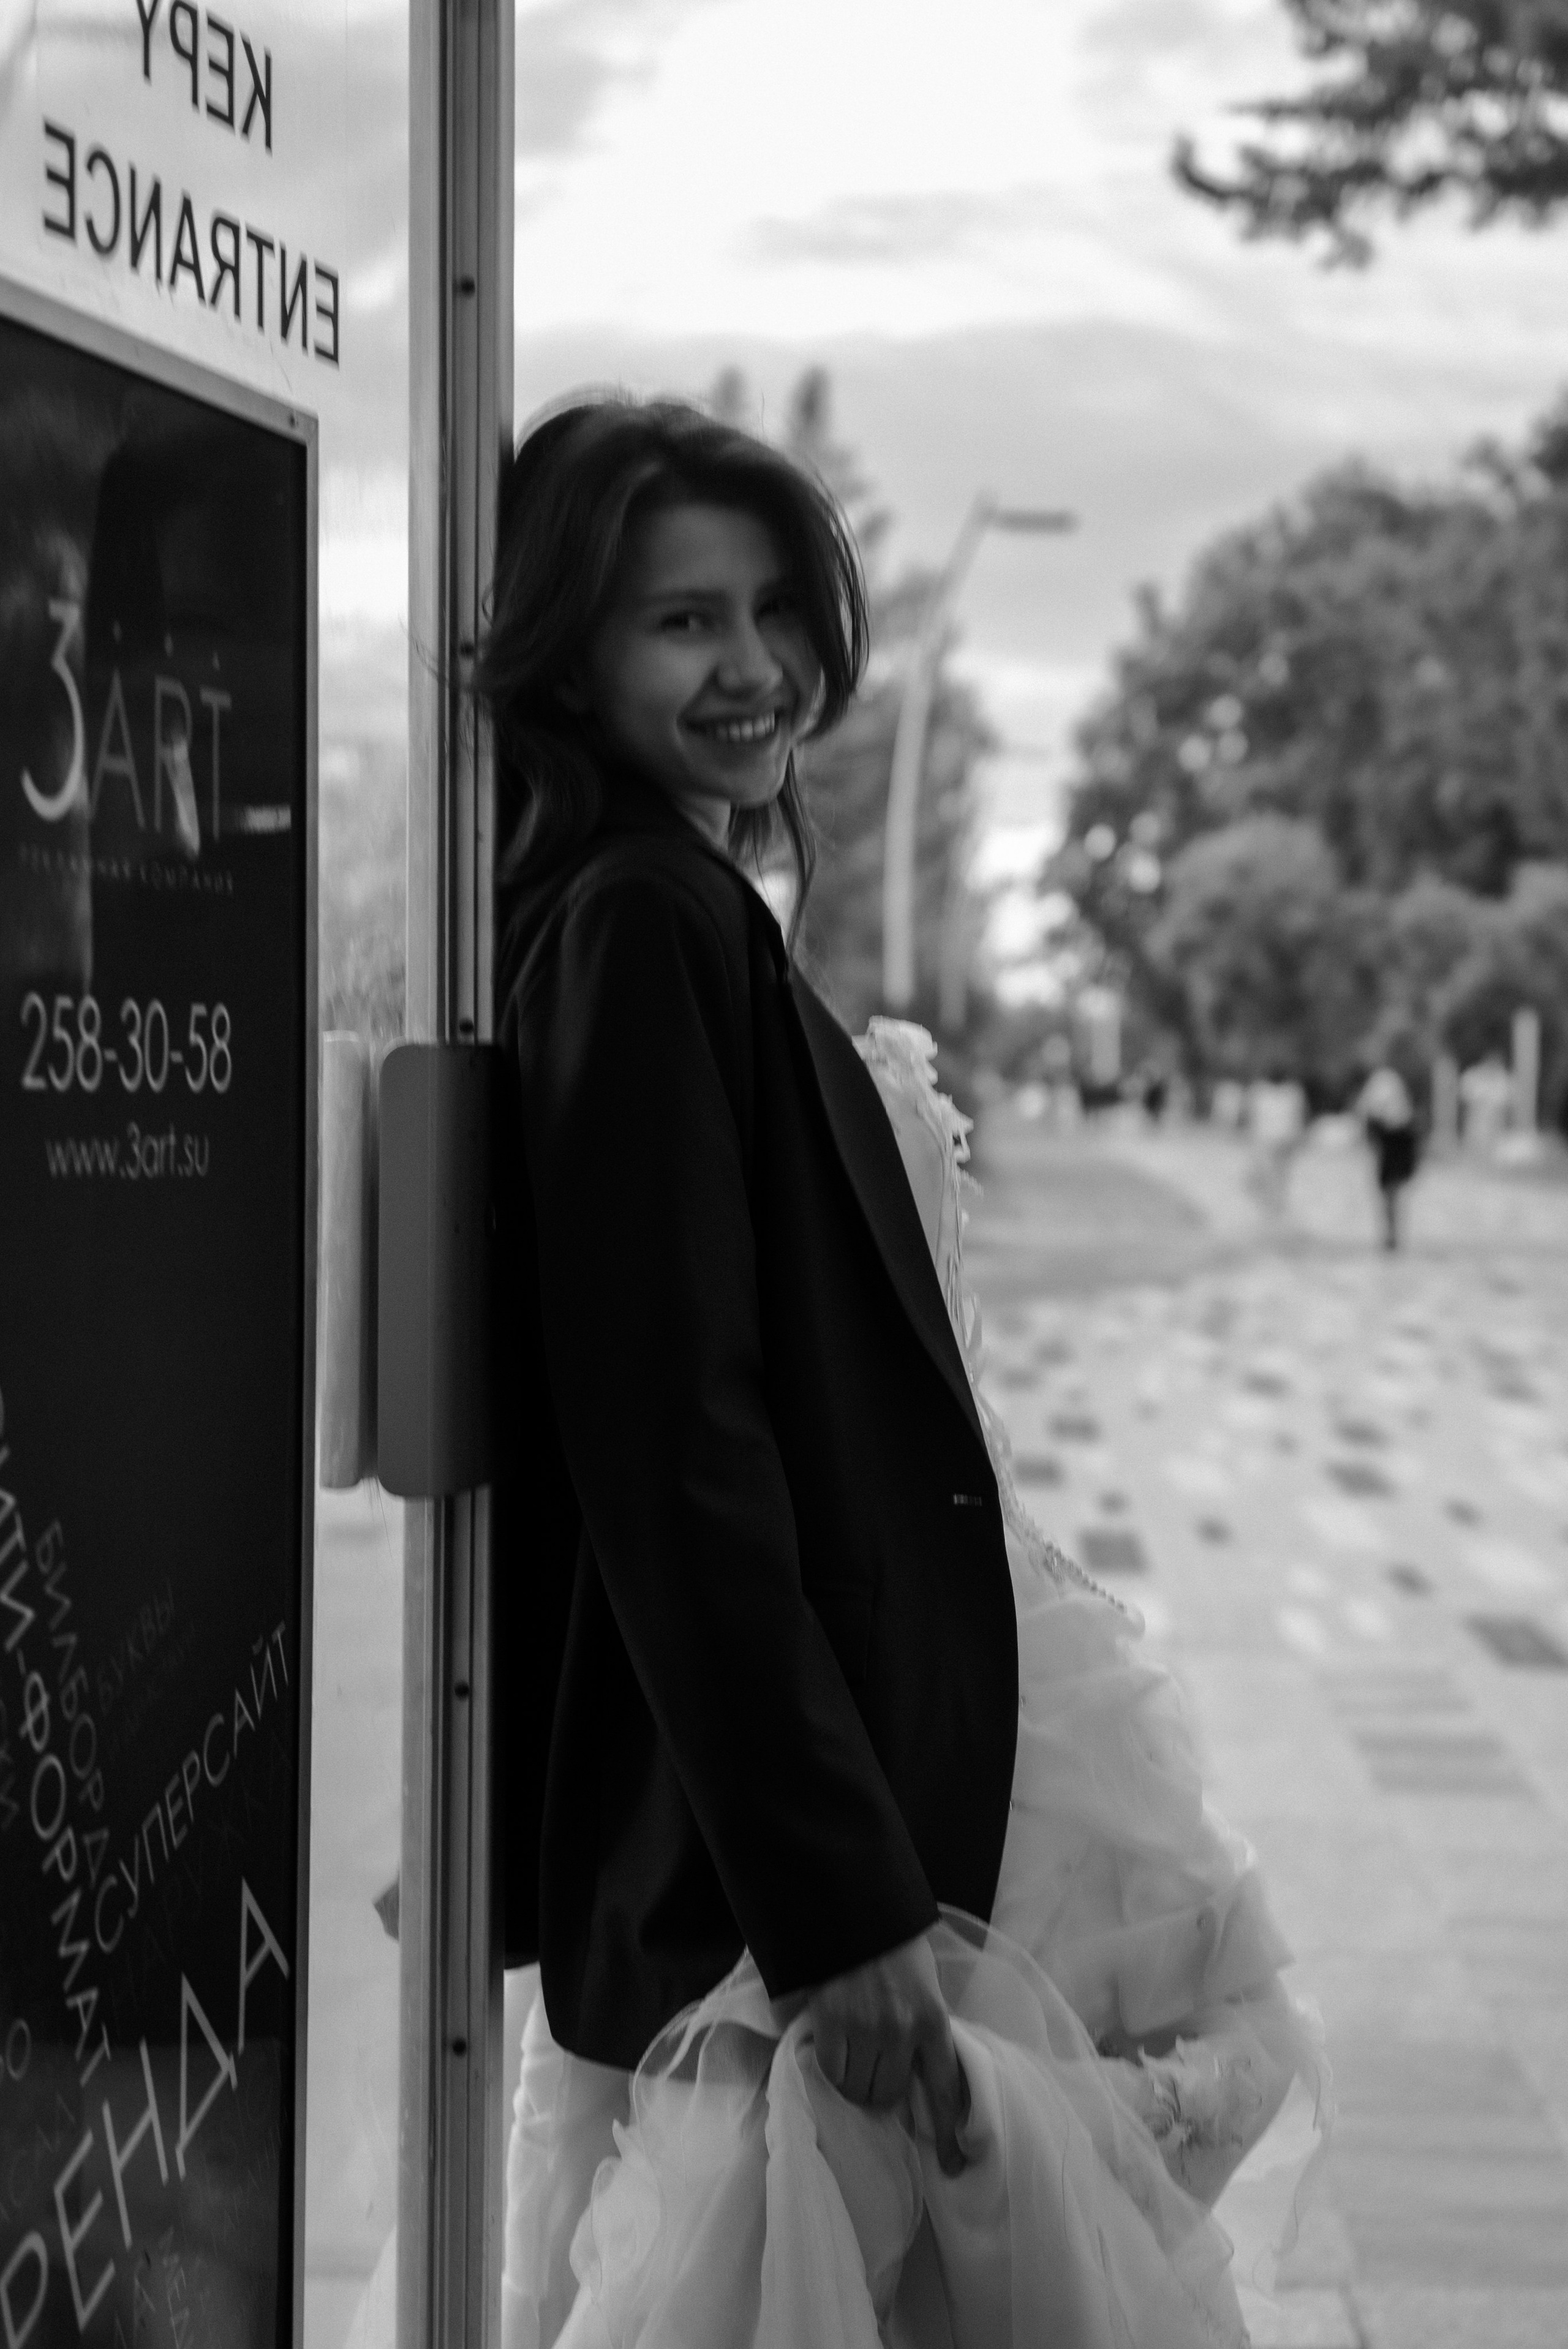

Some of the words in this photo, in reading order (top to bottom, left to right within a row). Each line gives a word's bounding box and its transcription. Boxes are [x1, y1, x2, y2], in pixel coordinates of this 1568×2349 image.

[19, 597, 234, 854] 3ART
[19, 990, 233, 1095] 258-30-58
[43, 1120, 210, 1181] www.3art.su
[35, 1516, 109, 1890] БИЛБОРД
[92, 1619, 288, 1955] СУПЕРСАЙТ
